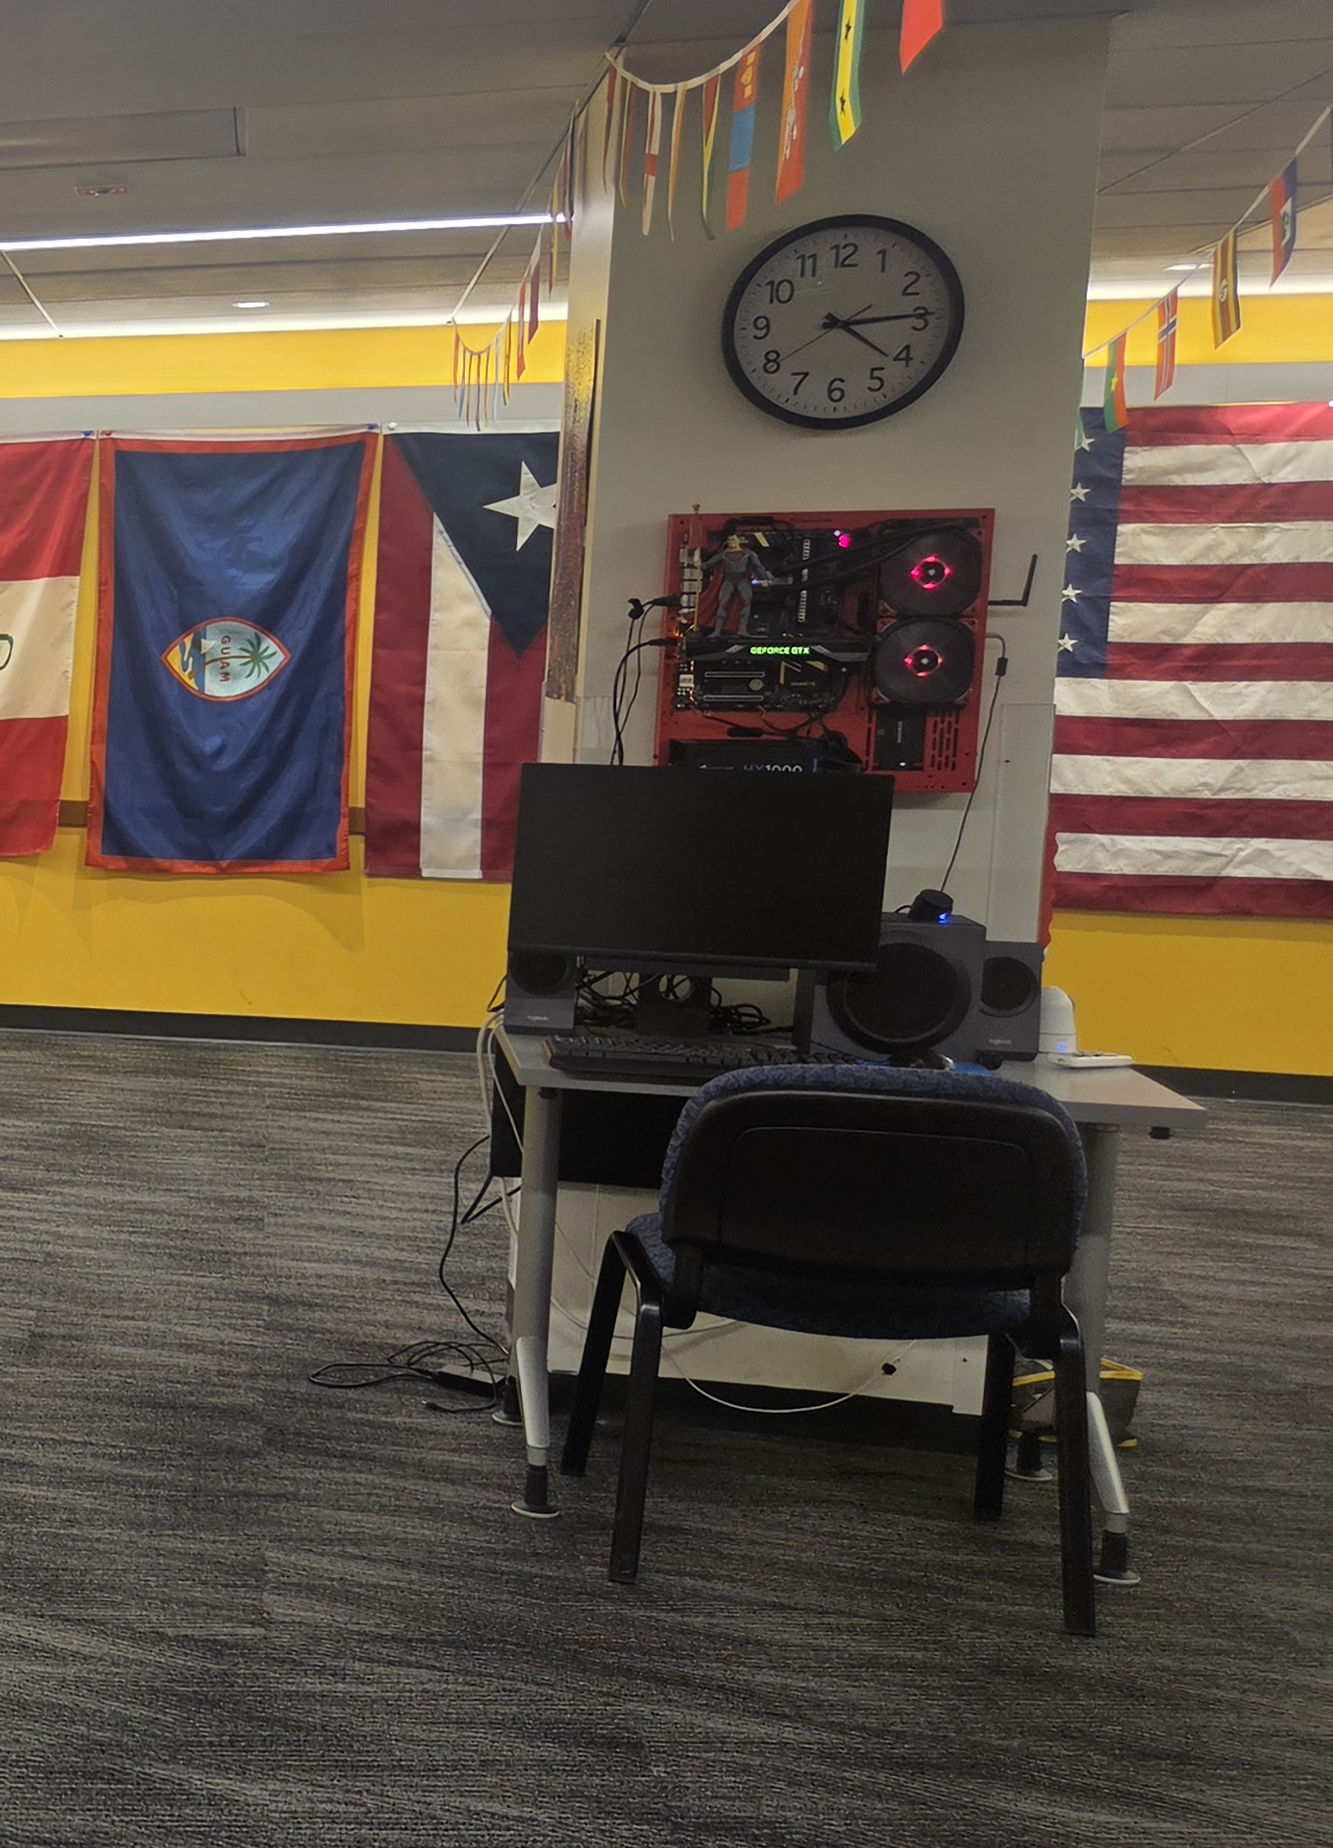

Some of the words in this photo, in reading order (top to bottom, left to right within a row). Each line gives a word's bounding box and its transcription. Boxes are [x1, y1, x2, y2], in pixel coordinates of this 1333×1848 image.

[796, 253, 817, 278] 11
[830, 243, 859, 268] 12
[876, 248, 887, 273] 1
[765, 279, 795, 304] 10
[902, 271, 921, 296] 2
[752, 315, 771, 340] 9
[911, 306, 929, 331] 3
[762, 350, 781, 374] 8
[892, 344, 913, 368] 4
[790, 371, 810, 396] 7
[827, 378, 846, 403] 6
[867, 367, 885, 392] 5
[219, 635, 231, 683] GUAM
[750, 646, 790, 655] GEFORCE
[790, 646, 810, 655] GTX
